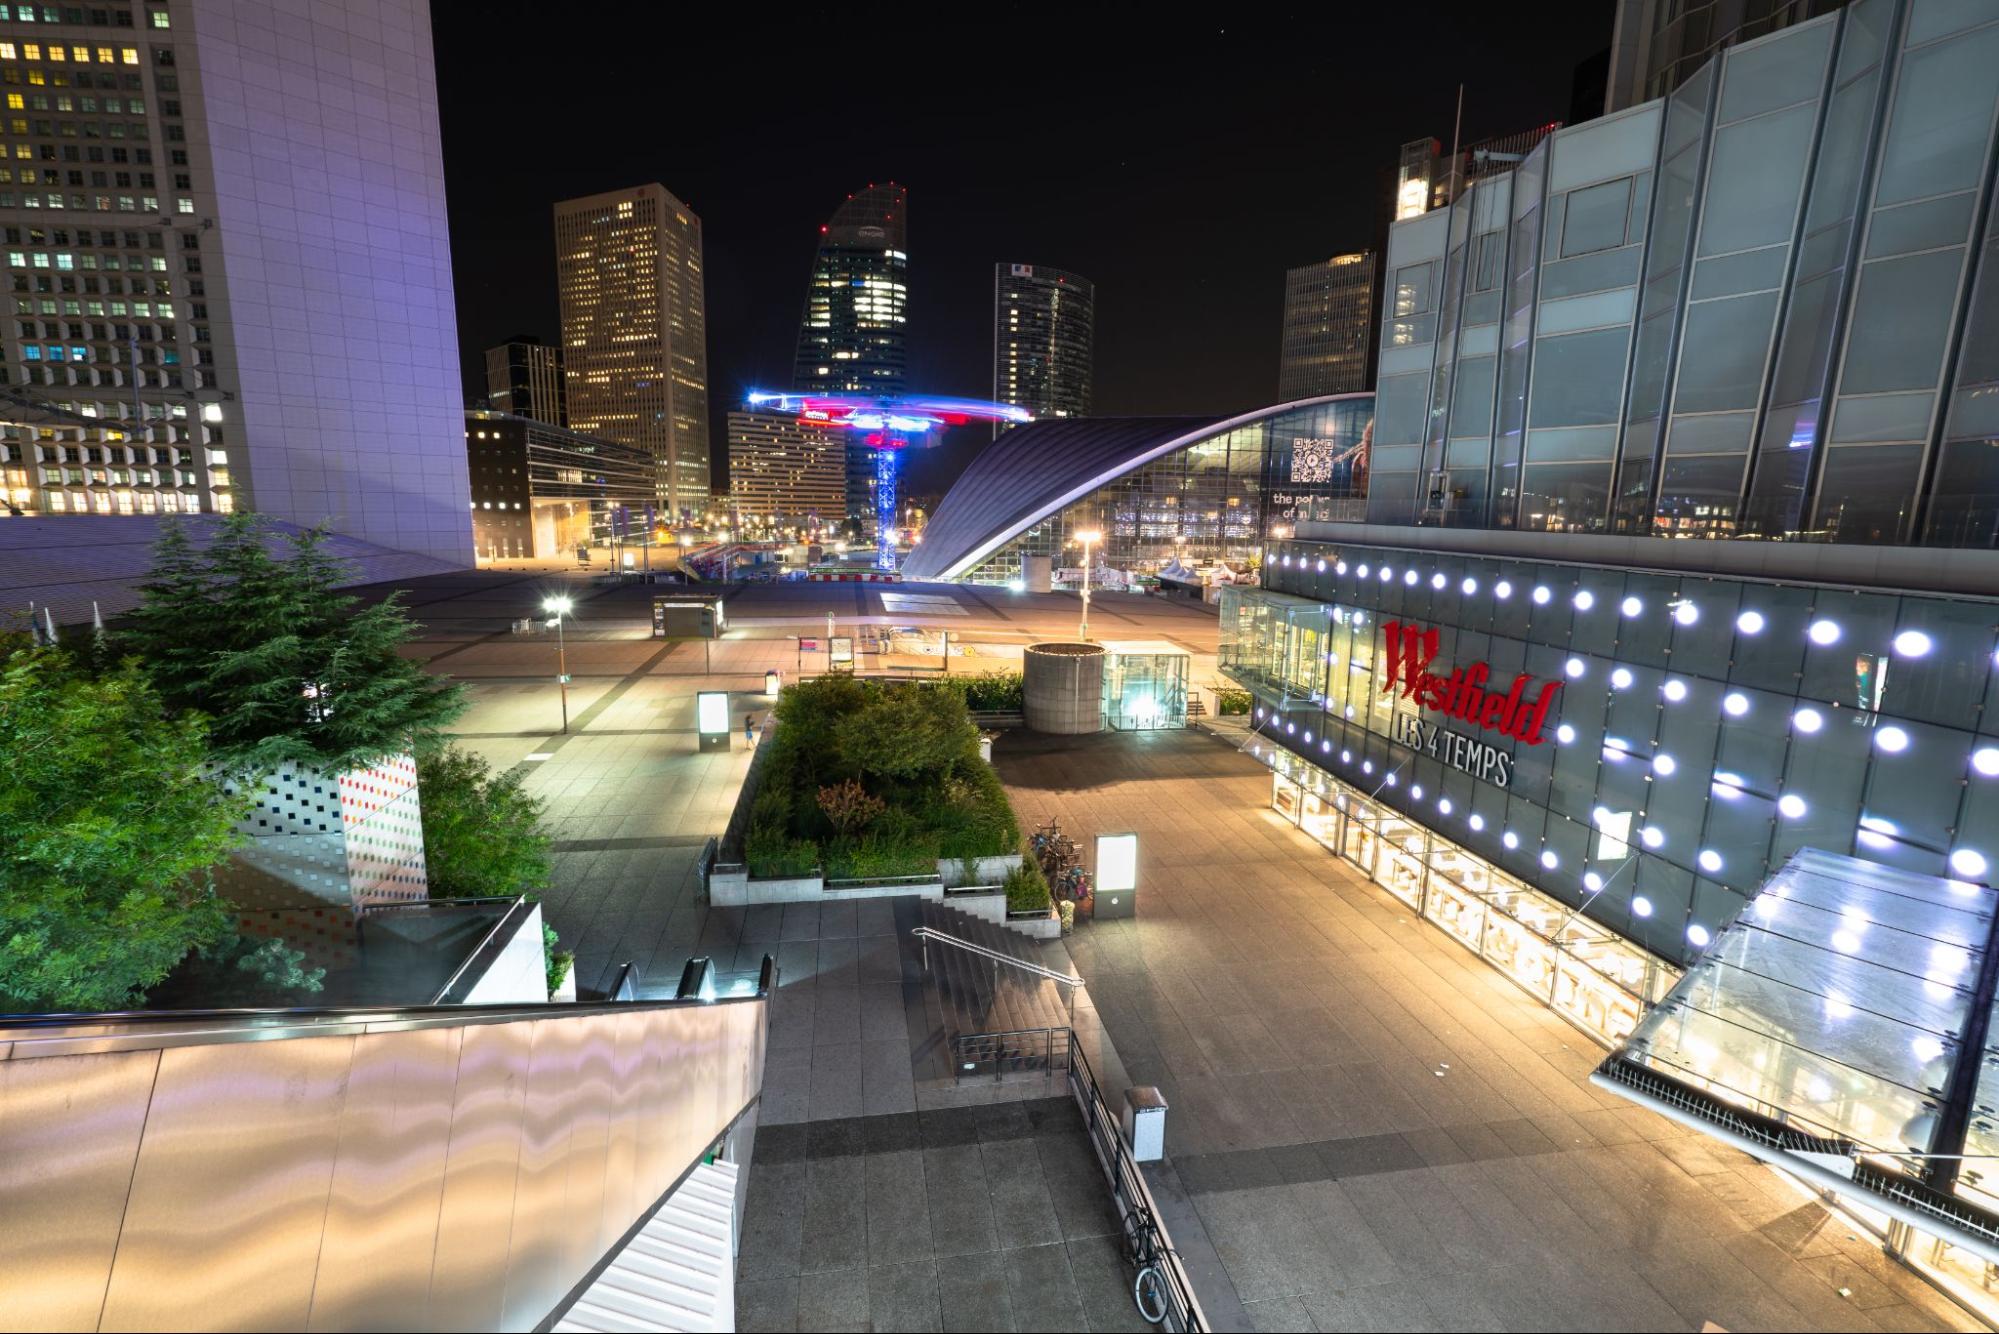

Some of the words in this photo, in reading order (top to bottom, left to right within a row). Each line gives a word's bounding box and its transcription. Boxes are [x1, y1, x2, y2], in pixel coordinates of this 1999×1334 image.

[1273, 493, 1292, 504] the
[1283, 507, 1295, 518] of
[1380, 619, 1564, 746] Westfield
[1395, 713, 1426, 752] LES
[1427, 727, 1439, 759] 4
[1443, 731, 1510, 788] TEMPS
